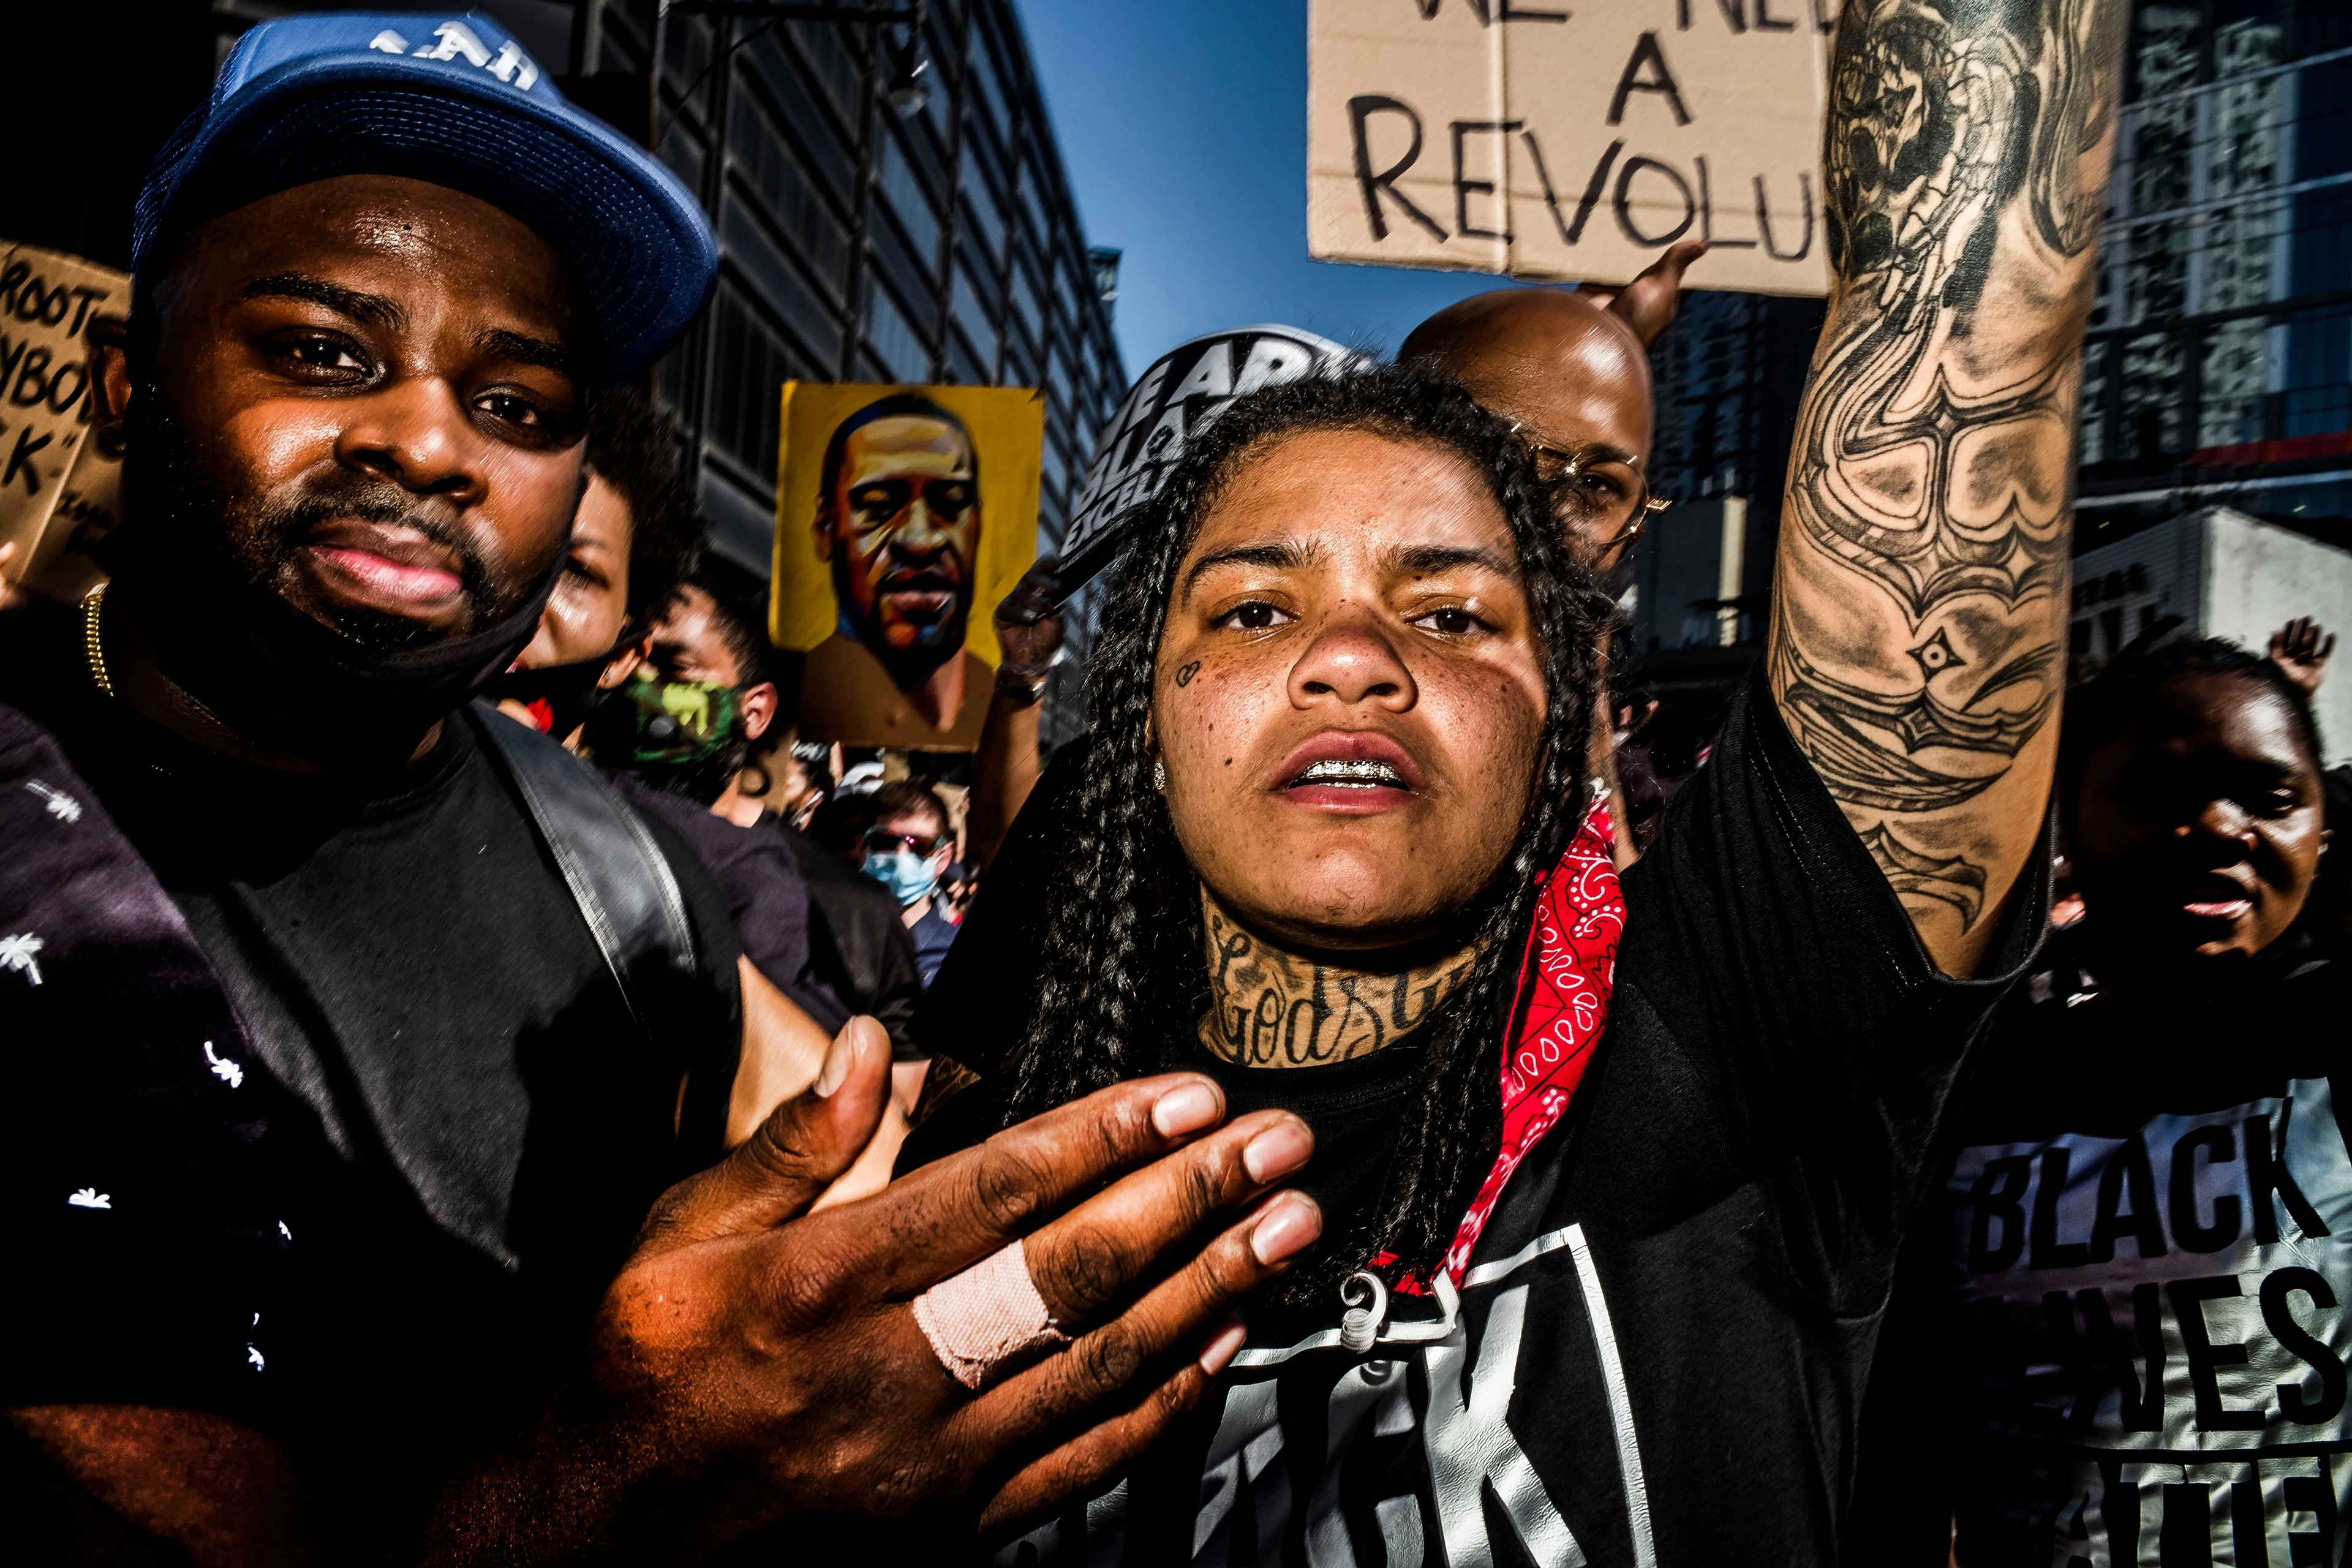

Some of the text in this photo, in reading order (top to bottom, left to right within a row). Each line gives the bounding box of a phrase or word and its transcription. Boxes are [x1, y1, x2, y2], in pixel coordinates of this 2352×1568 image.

[1606, 28, 1695, 126] A
[0, 334, 92, 424] YBO
[1967, 1097, 2331, 1275] BLACK
[1996, 1456, 2352, 1568] ATTE
